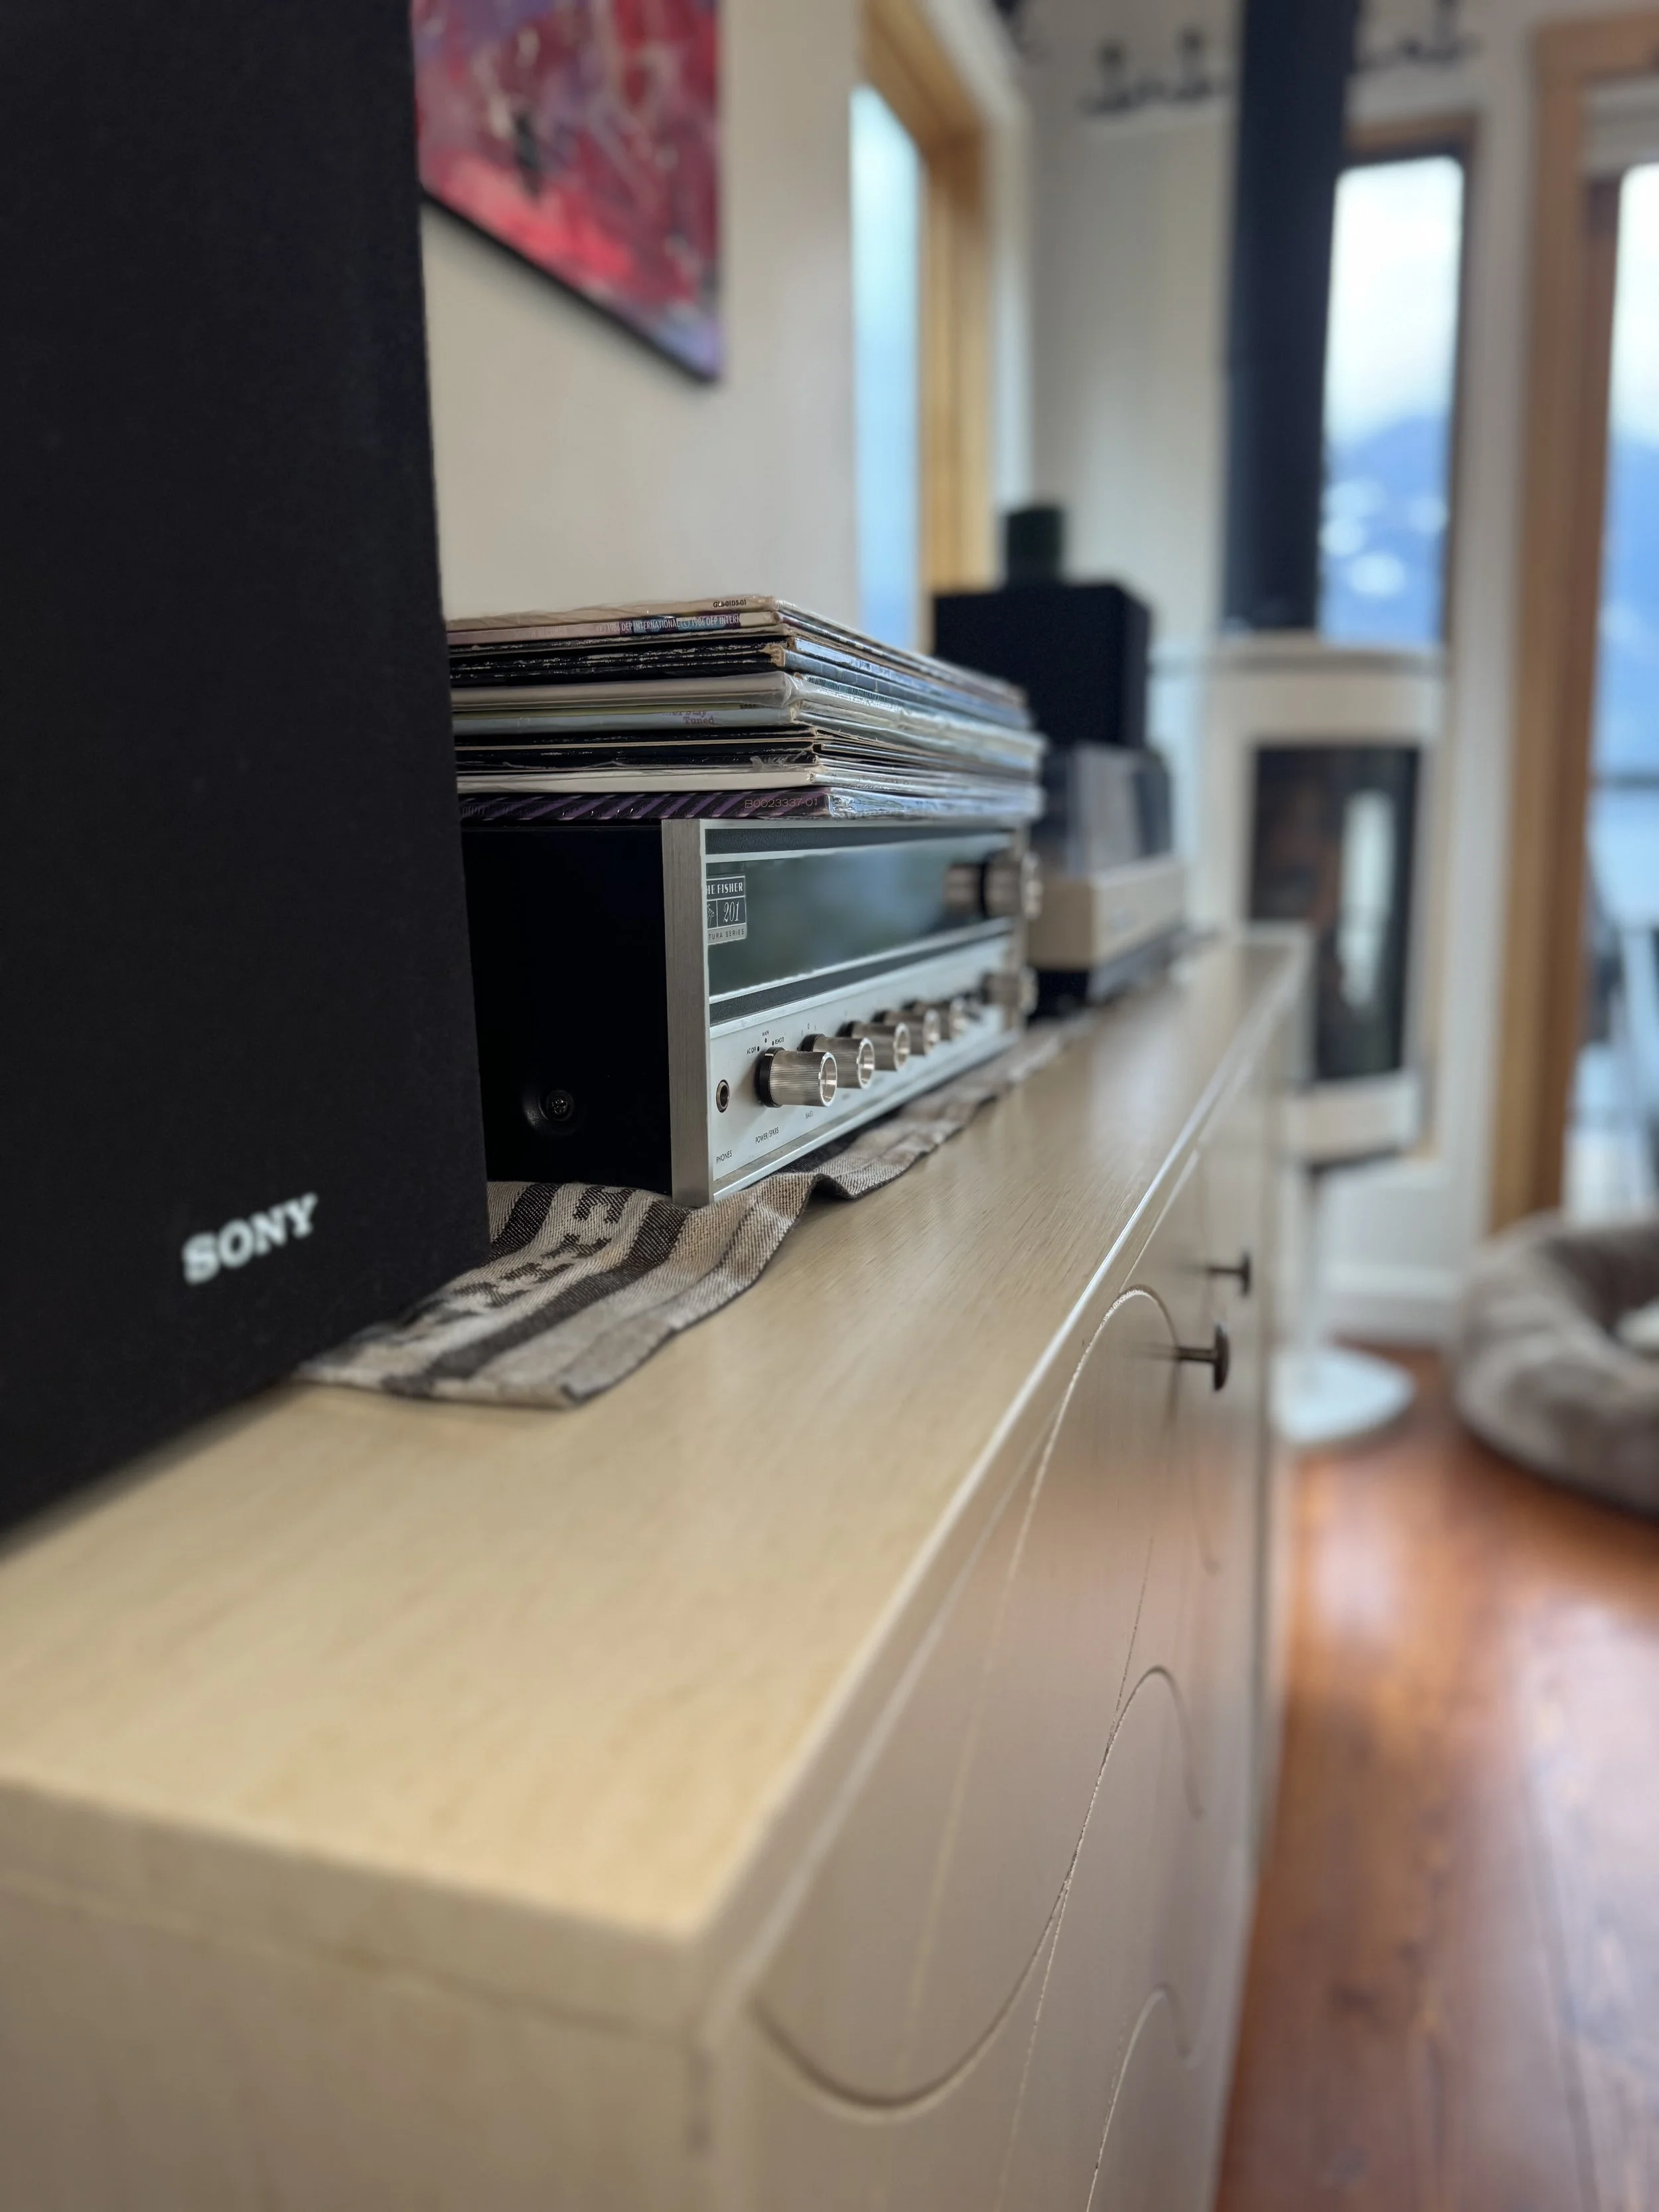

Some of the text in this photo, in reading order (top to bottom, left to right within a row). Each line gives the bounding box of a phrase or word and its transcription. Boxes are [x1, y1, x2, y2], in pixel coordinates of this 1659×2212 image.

[632, 618, 680, 630] INTERNATIONAL
[683, 715, 714, 725] Tuned
[745, 798, 818, 808] B0023337-01
[717, 882, 743, 894] FISHER
[723, 901, 739, 922] 201
[725, 928, 744, 937] SERIES
[716, 1149, 733, 1164] PHONES
[181, 1191, 319, 1287] SONY
